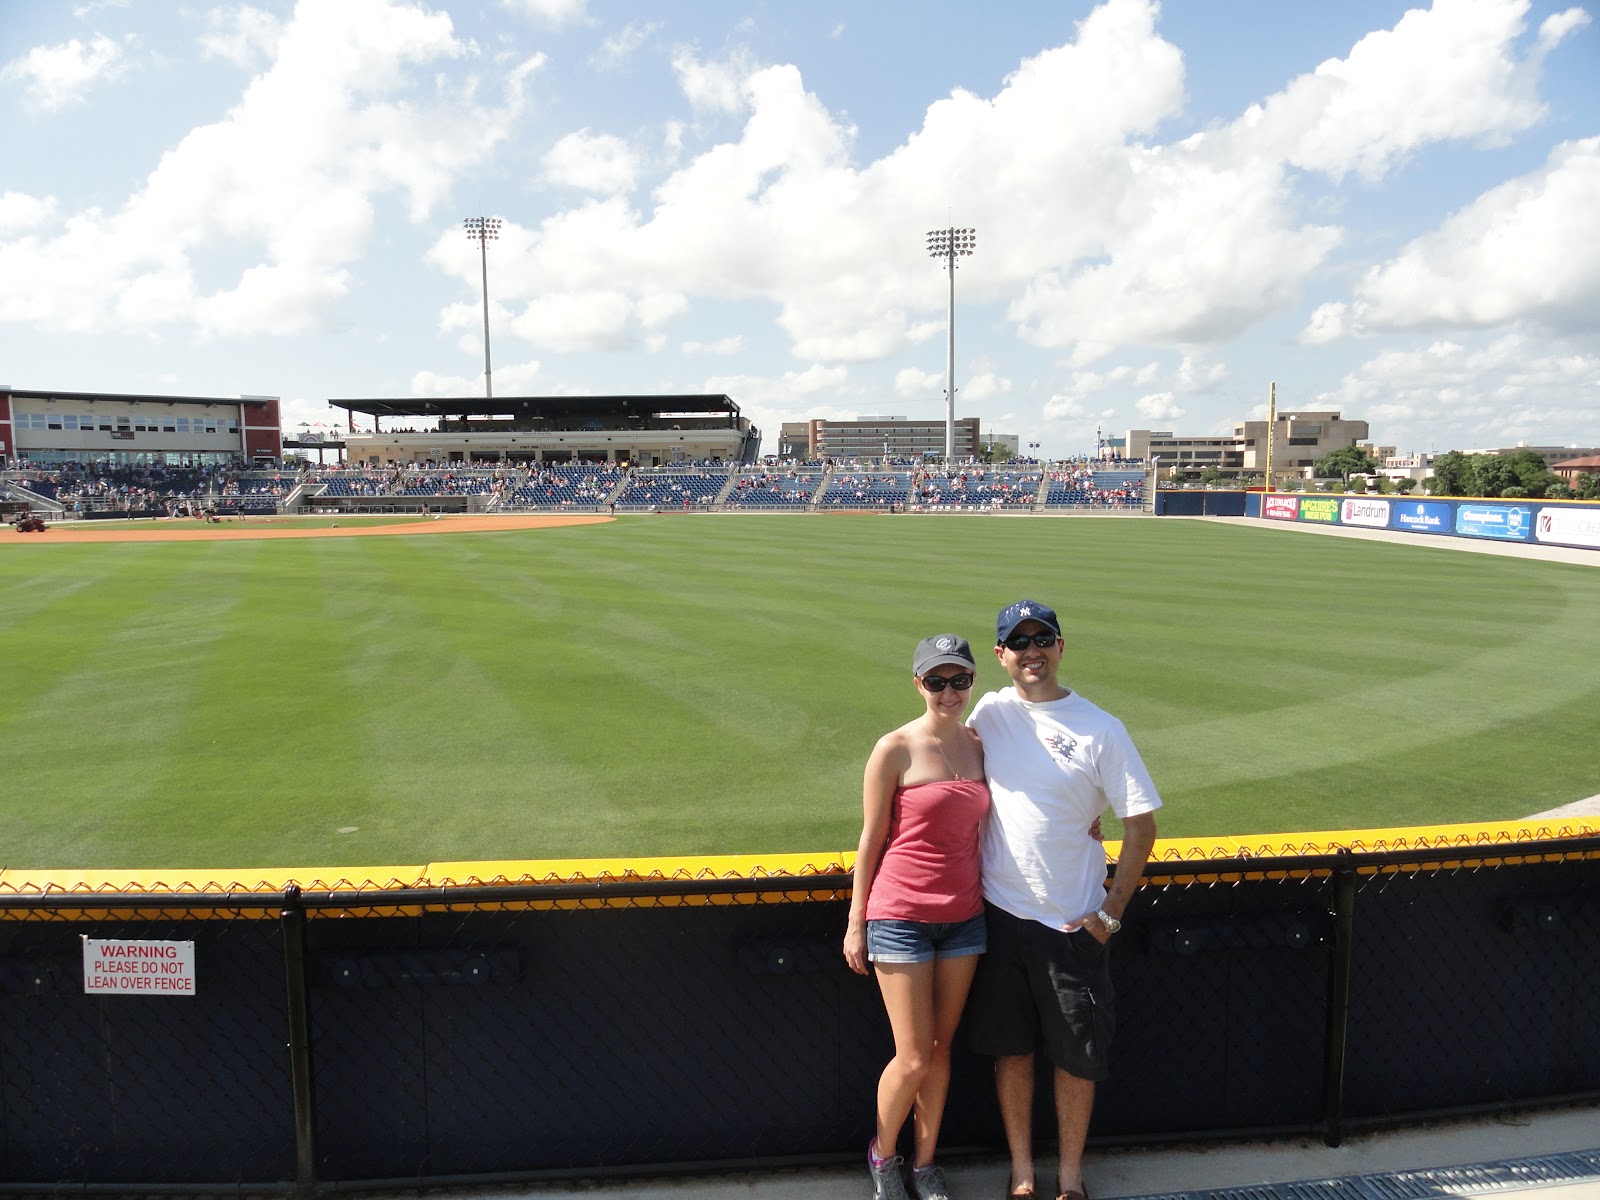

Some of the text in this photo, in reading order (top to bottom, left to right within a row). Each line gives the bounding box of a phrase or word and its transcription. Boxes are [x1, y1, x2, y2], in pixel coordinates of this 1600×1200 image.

[1320, 512, 1332, 520] PUB
[1353, 502, 1386, 519] Landrum
[1400, 513, 1424, 523] Hancock
[100, 945, 177, 959] WARNING
[94, 961, 184, 975] PLEASE DO NOT
[87, 976, 192, 990] LEAN OVER FENCE
